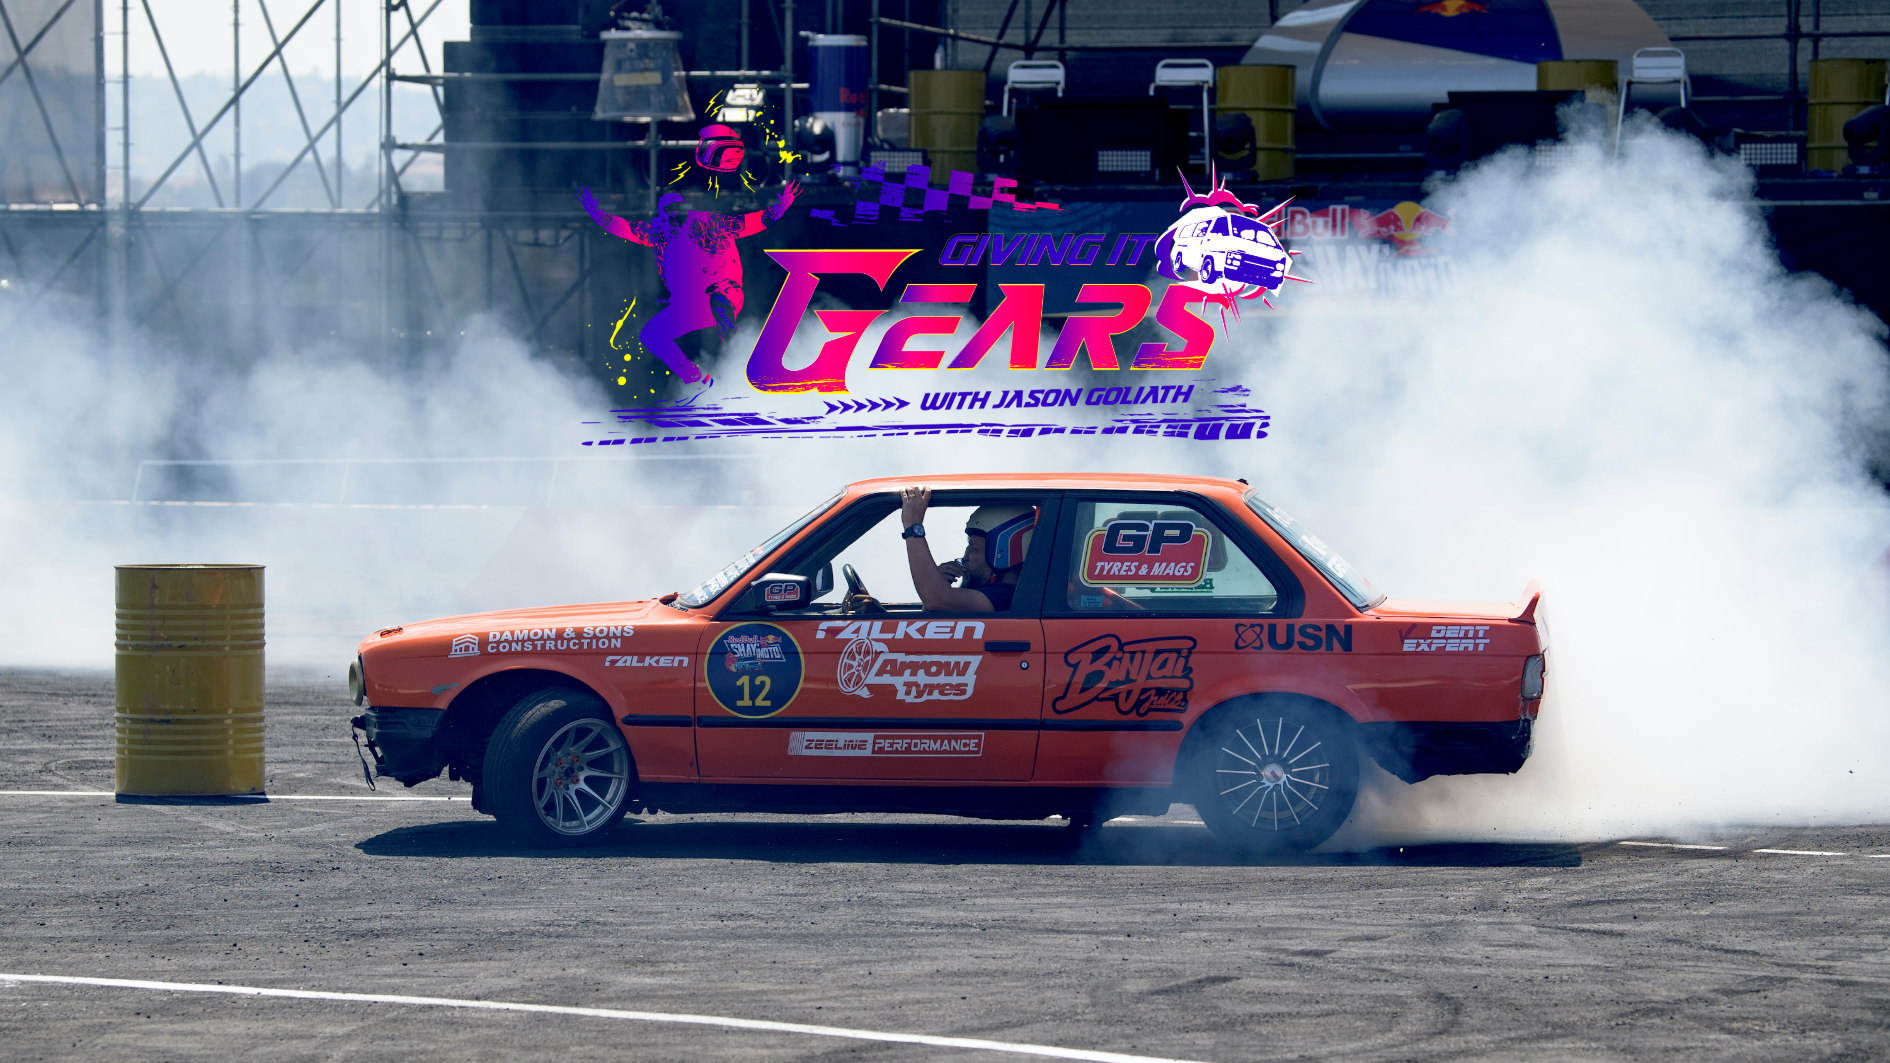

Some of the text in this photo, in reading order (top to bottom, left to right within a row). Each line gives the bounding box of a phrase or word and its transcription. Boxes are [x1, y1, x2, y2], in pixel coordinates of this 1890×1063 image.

[1286, 204, 1350, 240] Bull
[1102, 520, 1196, 555] GP
[1094, 561, 1195, 576] TYRES & MAGS
[769, 583, 798, 595] GP
[488, 625, 634, 642] DAMON & SONS
[816, 621, 985, 639] FALKEN
[1267, 623, 1353, 652] USN
[1430, 625, 1490, 638] DENT
[487, 638, 621, 653] CONSTRUCTION
[728, 635, 758, 643] Red Bull
[1402, 639, 1490, 652] EXPERT
[605, 656, 689, 667] FALKEN
[736, 675, 772, 707] 12
[903, 681, 969, 699] Tyres
[804, 739, 979, 751] ZEELINE PERFORMANCE
